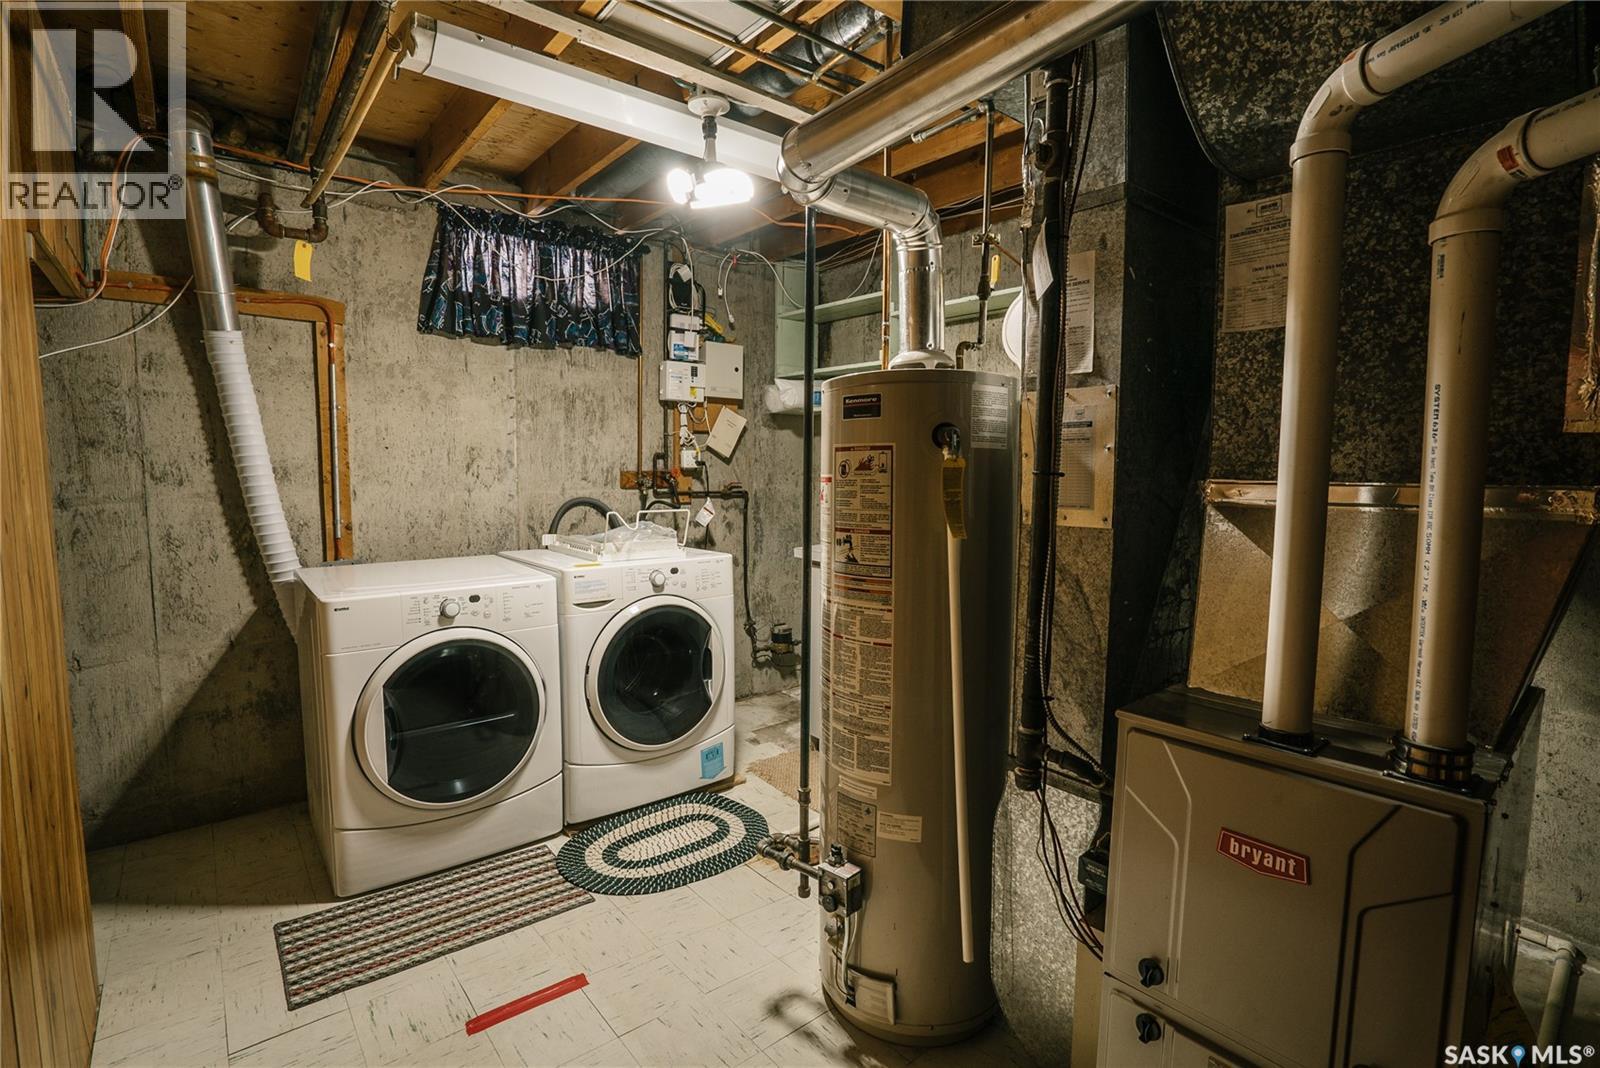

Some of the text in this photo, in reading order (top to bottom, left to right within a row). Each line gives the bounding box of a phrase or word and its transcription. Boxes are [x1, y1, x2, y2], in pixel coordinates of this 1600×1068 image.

[845, 396, 879, 405] Kenmore
[1432, 384, 1441, 420] SYSTEM
[1425, 532, 1433, 555] 50MM
[1229, 837, 1296, 876] bryant
